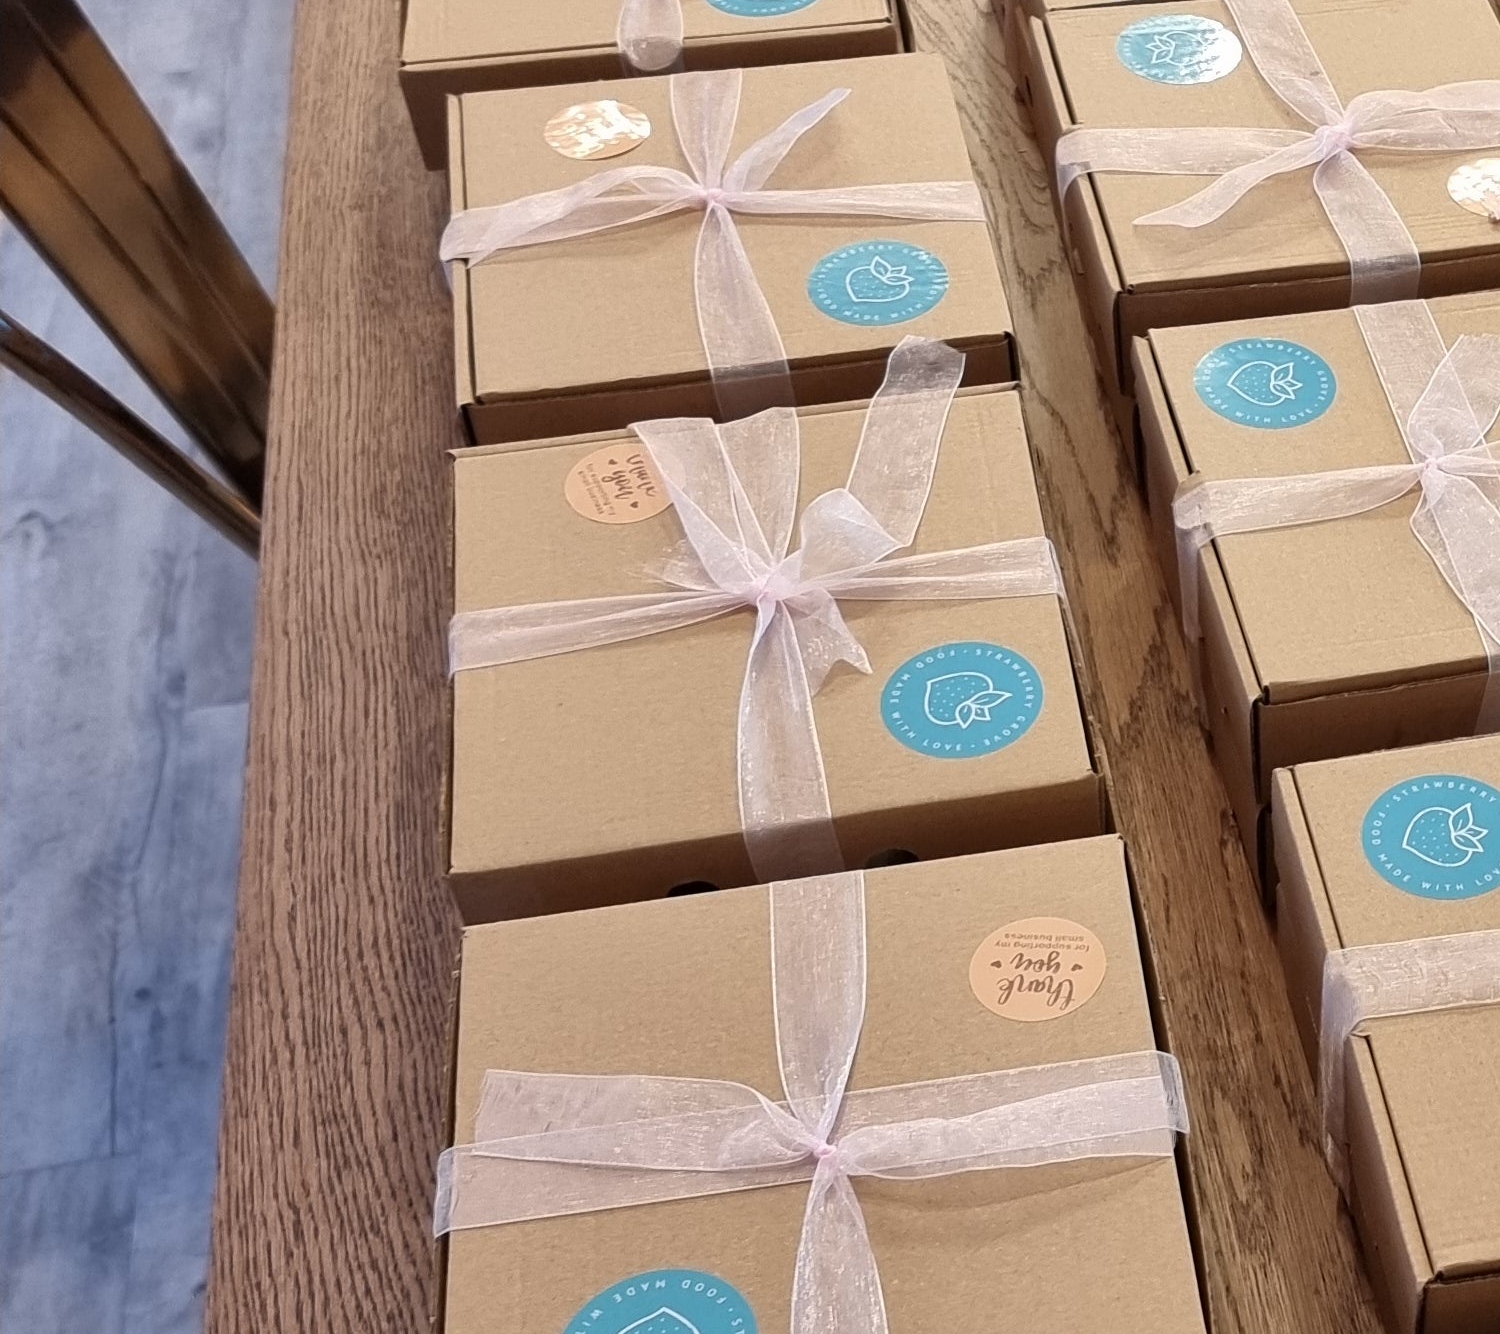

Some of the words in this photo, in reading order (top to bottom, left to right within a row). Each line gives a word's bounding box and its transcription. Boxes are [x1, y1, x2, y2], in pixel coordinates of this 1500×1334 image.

[915, 649, 955, 669] FOOD
[975, 648, 1035, 709] STRAWBERRY
[891, 711, 917, 740] WITH
[983, 715, 1026, 747] GROVE
[922, 739, 962, 751] LOVE
[1392, 781, 1497, 803] STRAWBERRY
[1371, 811, 1386, 846] FOOD
[1377, 853, 1412, 882] MADE
[1421, 881, 1464, 892] WITH
[612, 1279, 666, 1304] MADE
[681, 1279, 728, 1305] FOOD
